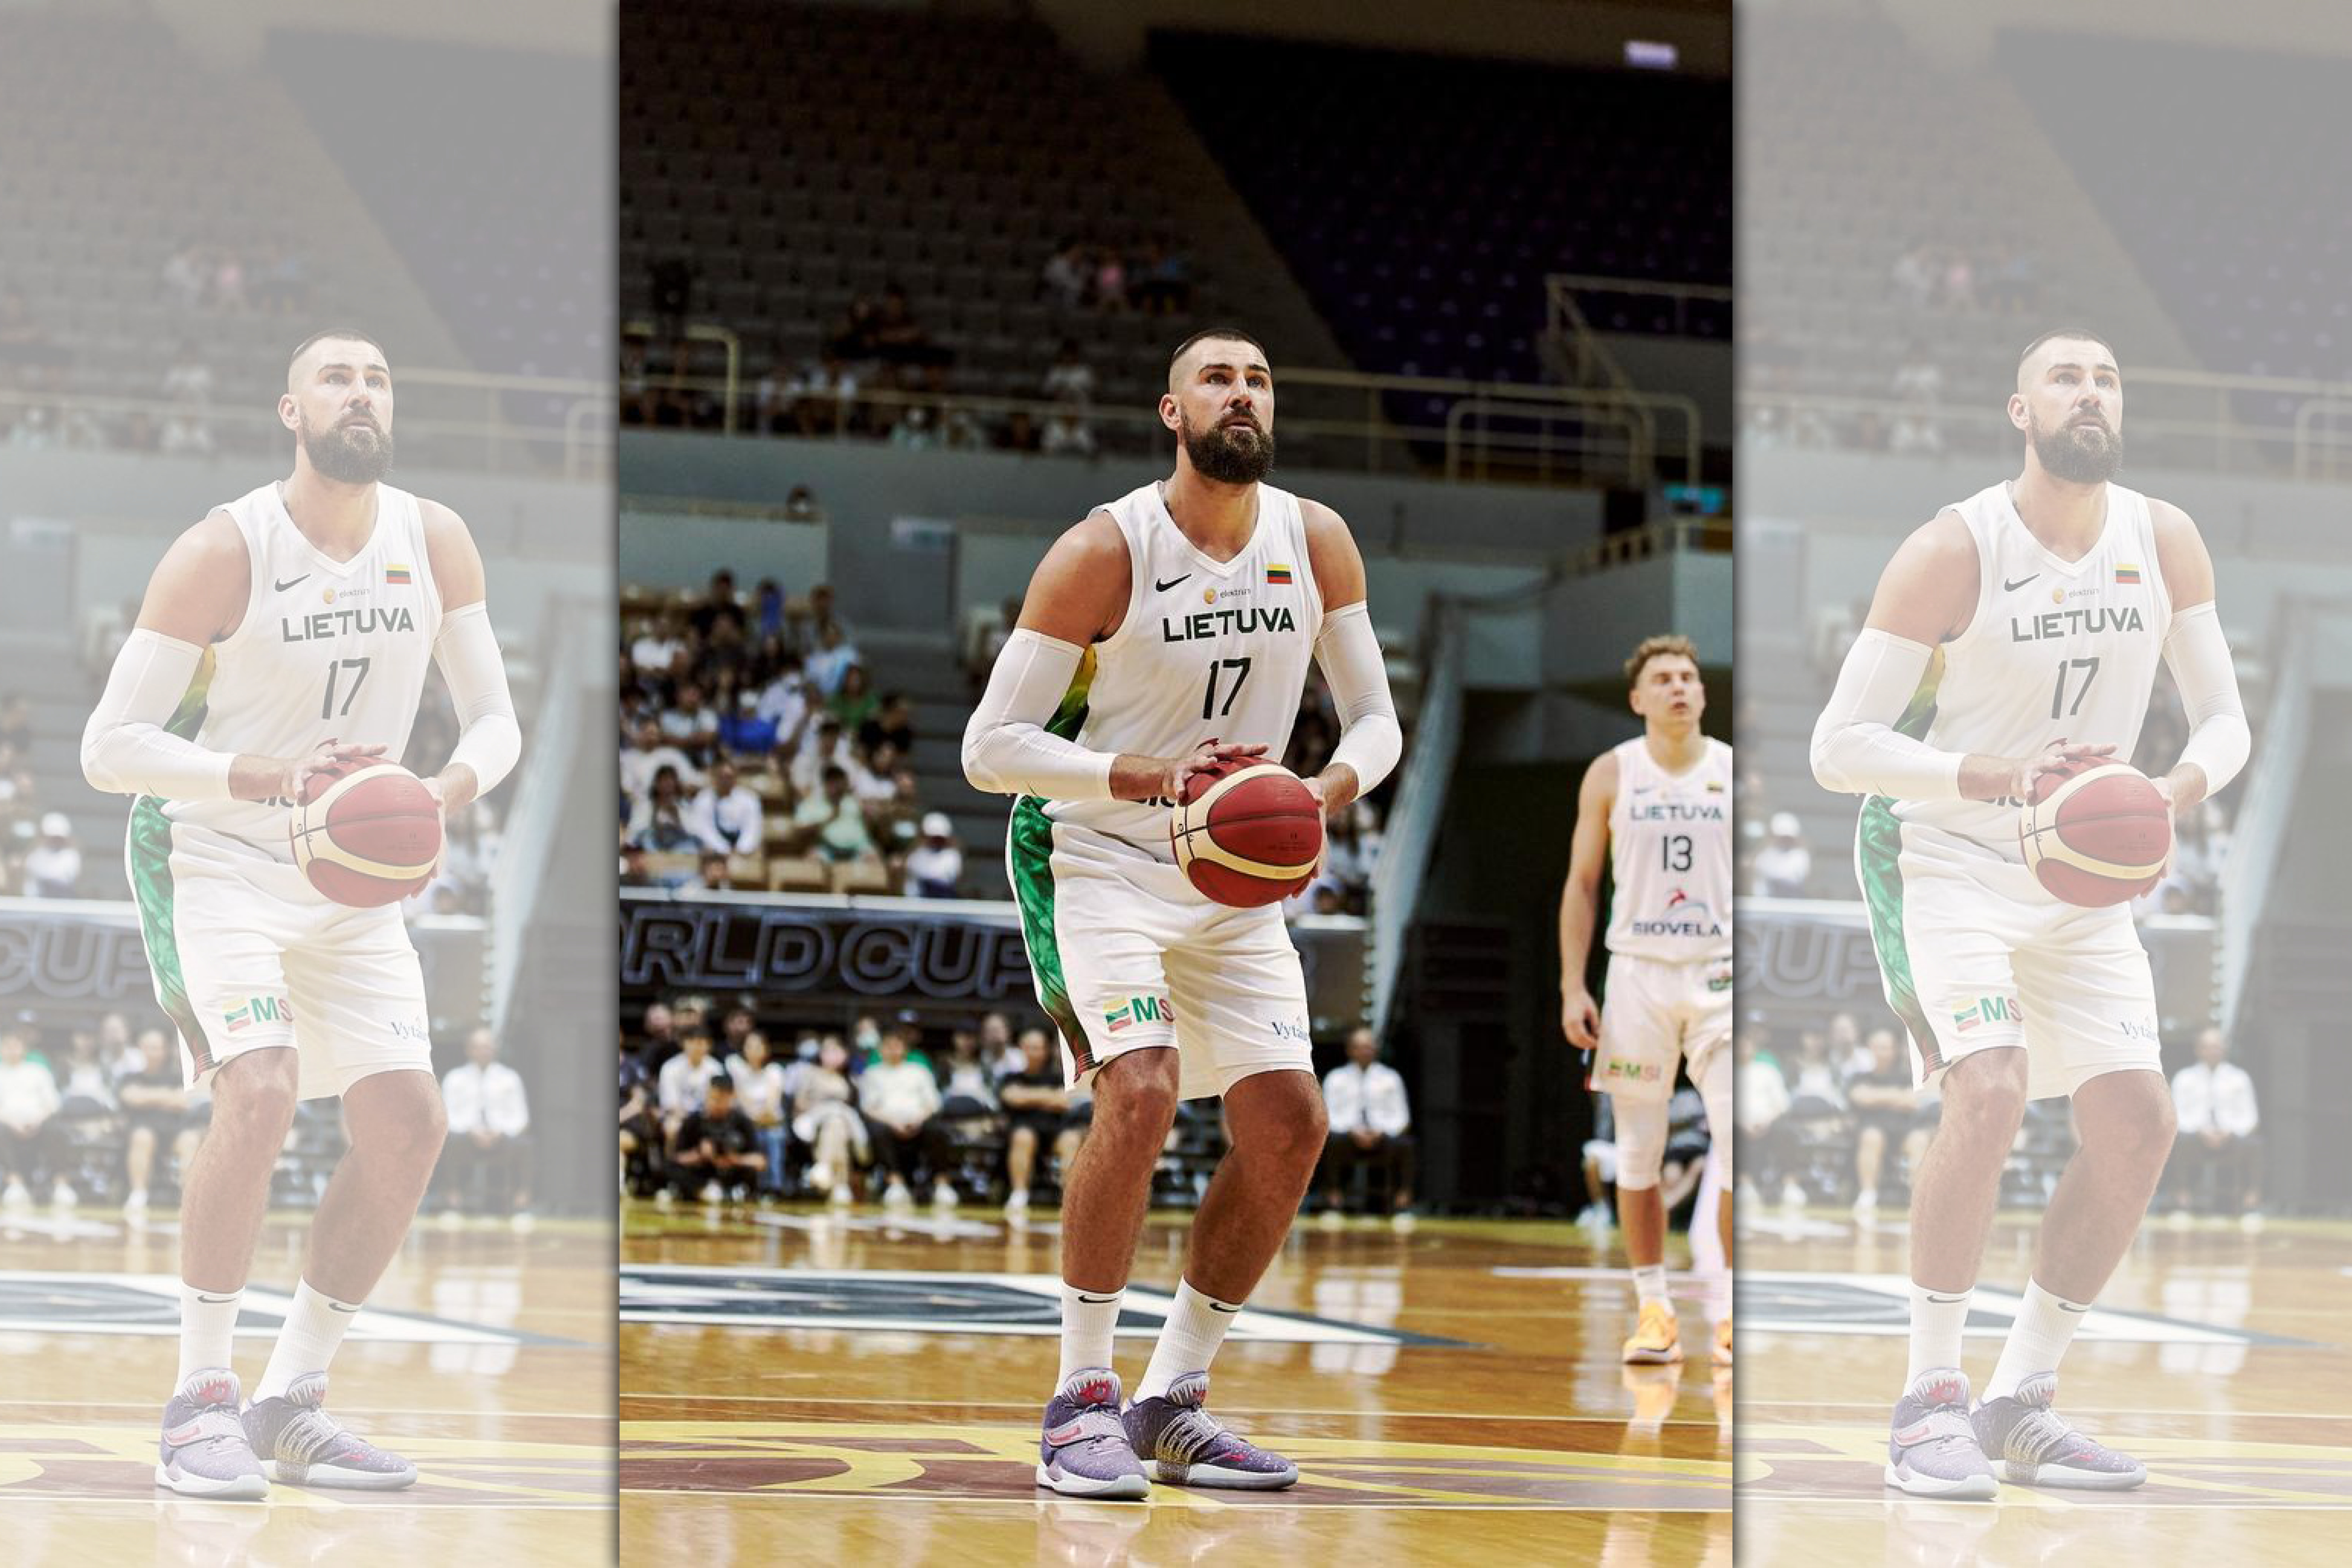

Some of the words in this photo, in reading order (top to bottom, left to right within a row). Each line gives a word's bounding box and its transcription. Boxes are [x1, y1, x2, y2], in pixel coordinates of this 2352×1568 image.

[283, 607, 415, 643] LIETUVA
[1163, 607, 1295, 643] LIETUVA
[2012, 607, 2144, 643] LIETUVA
[322, 658, 371, 720] 17
[1203, 658, 1252, 720] 17
[2051, 658, 2100, 720] 17
[1630, 804, 1723, 821] LIETUVA
[1663, 835, 1693, 872] 13
[1633, 921, 1723, 938] BIOVELA
[620, 906, 830, 990] RLD
